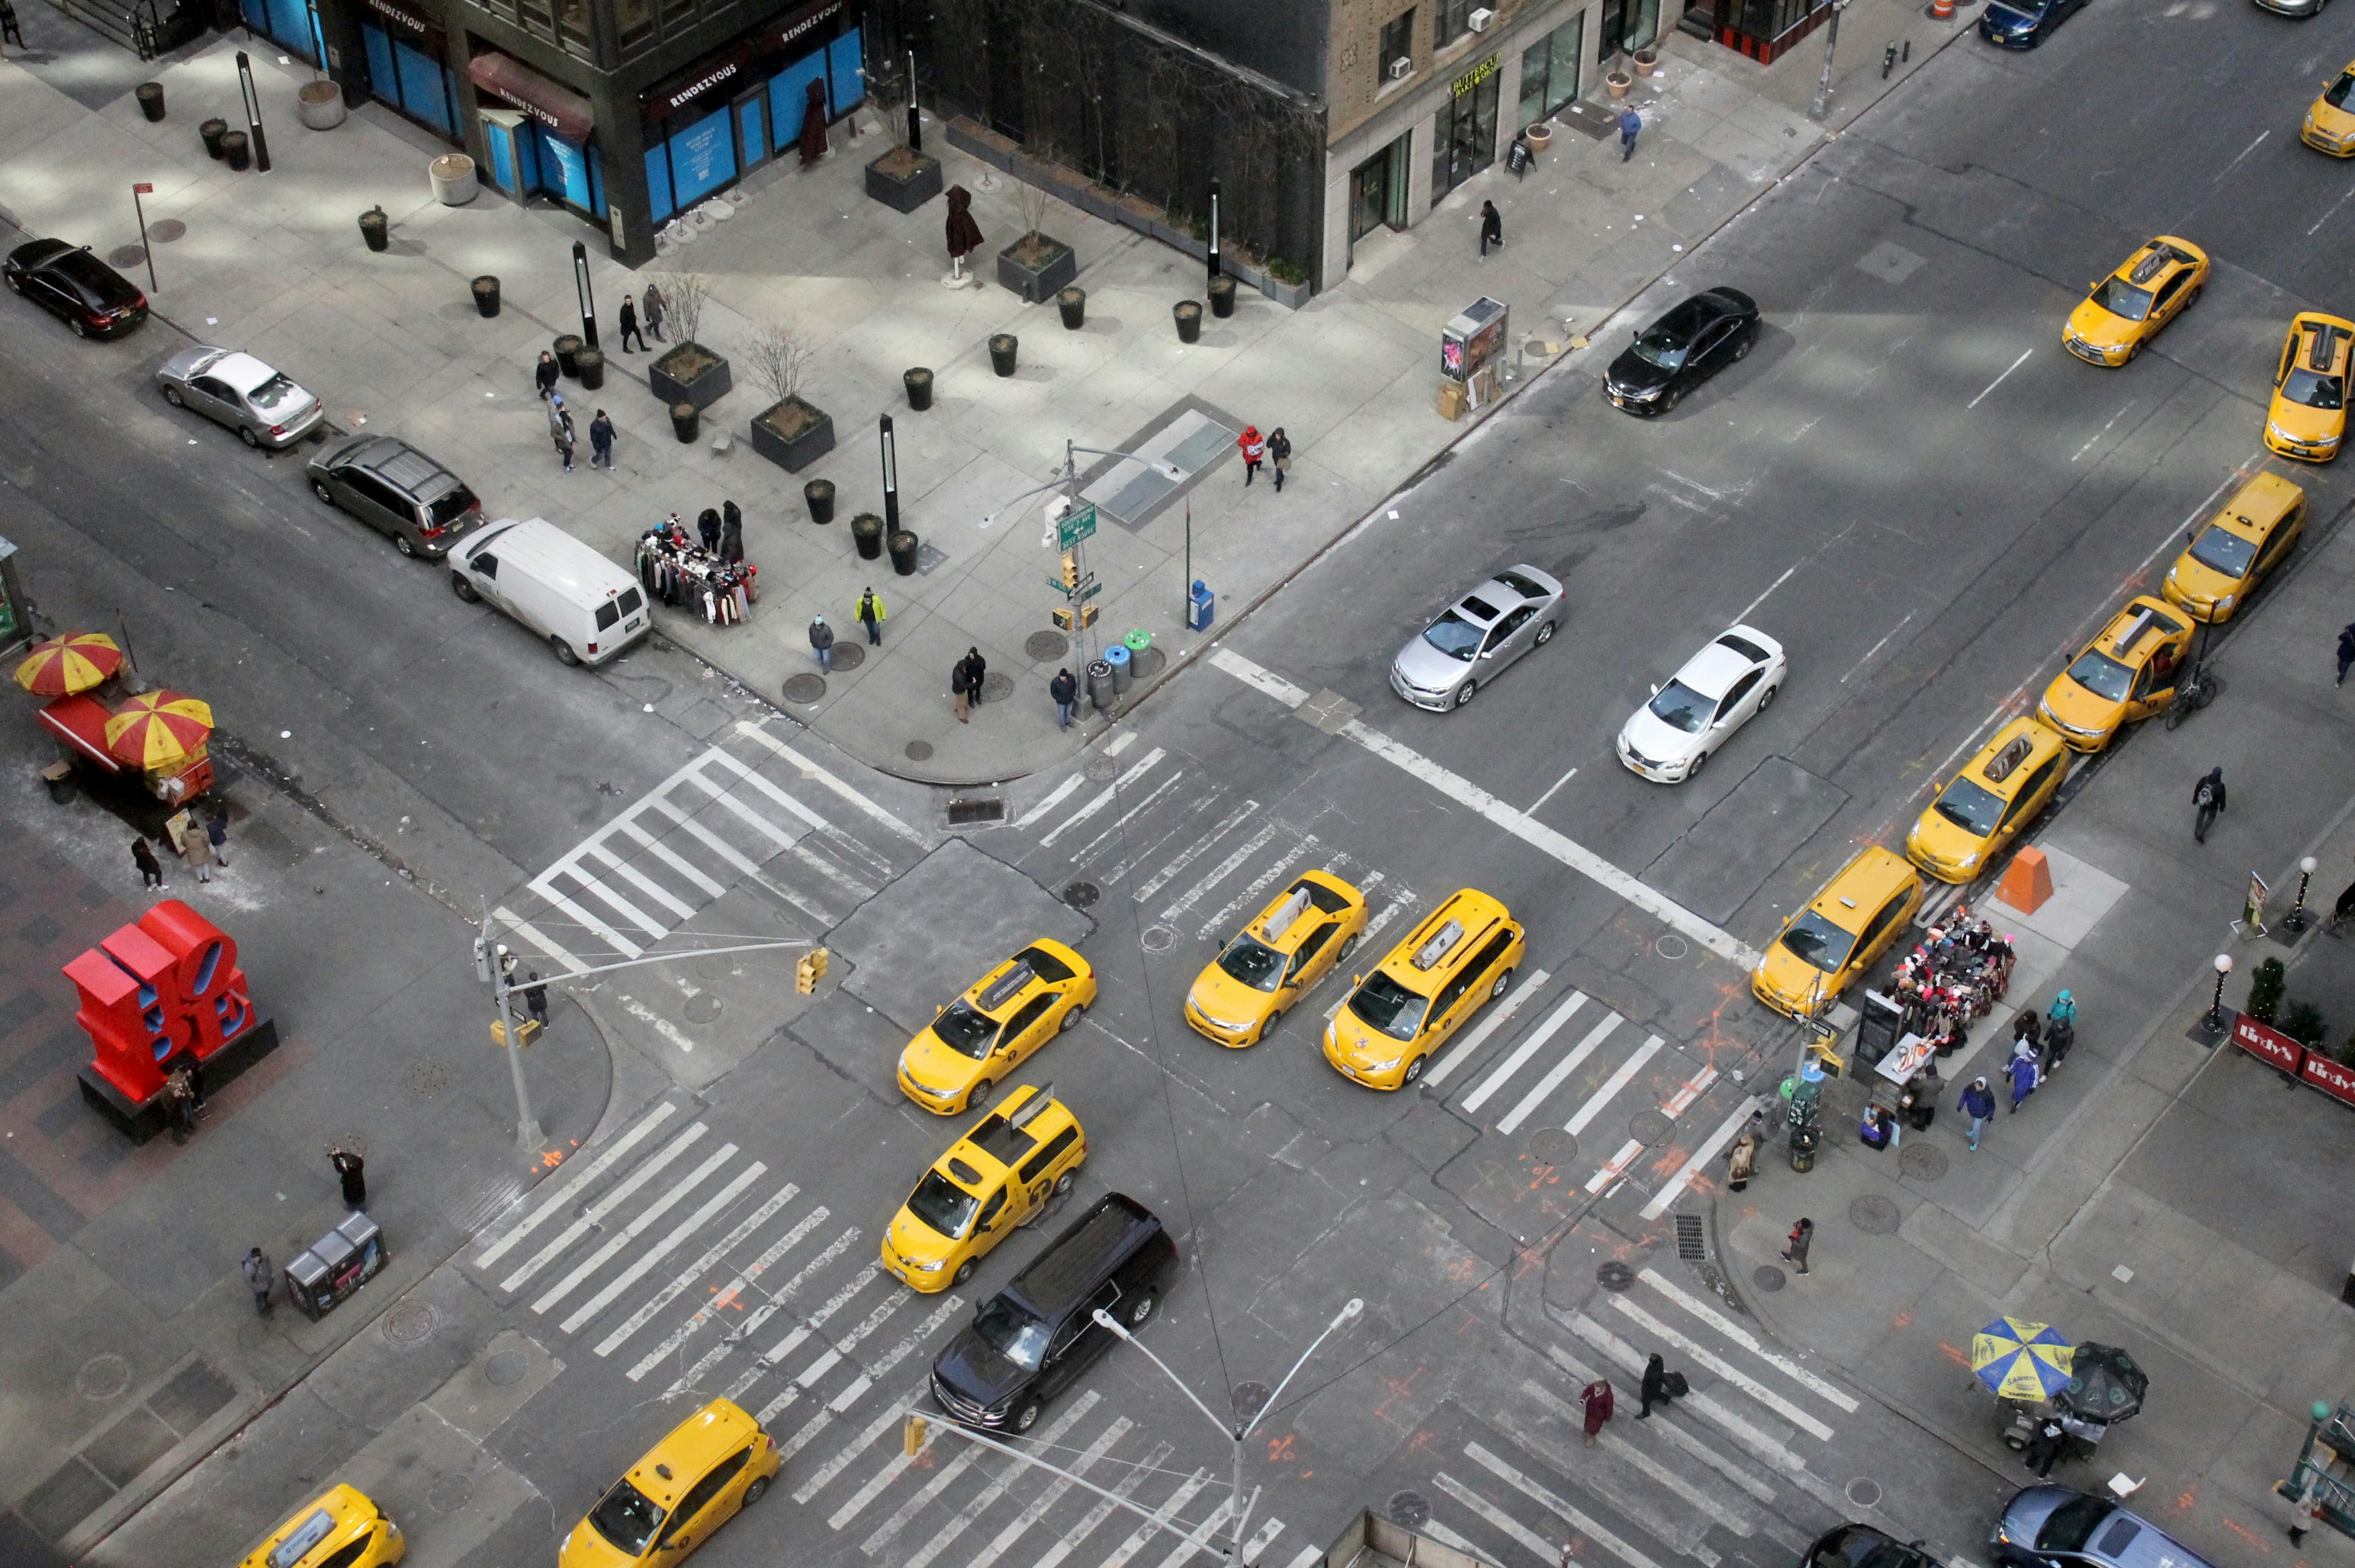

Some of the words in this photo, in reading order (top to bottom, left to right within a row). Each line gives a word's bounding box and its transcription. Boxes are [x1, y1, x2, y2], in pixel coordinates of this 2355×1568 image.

[369, 0, 426, 32] RENDEZVOUS
[782, 2, 843, 42] RENDEZVOUS
[670, 63, 737, 108] RENDEZVOUS
[1453, 52, 1501, 92] BUTTERCUP
[1455, 80, 1474, 98] BAKE
[500, 87, 559, 127] RENDEZVOUS
[1061, 506, 1094, 529] SOUTHBOUND
[1064, 523, 1075, 533] USE
[1077, 527, 1094, 541] ROUTE
[2239, 1024, 2292, 1062] Lindy's
[2308, 1060, 2355, 1094] Lindy'
